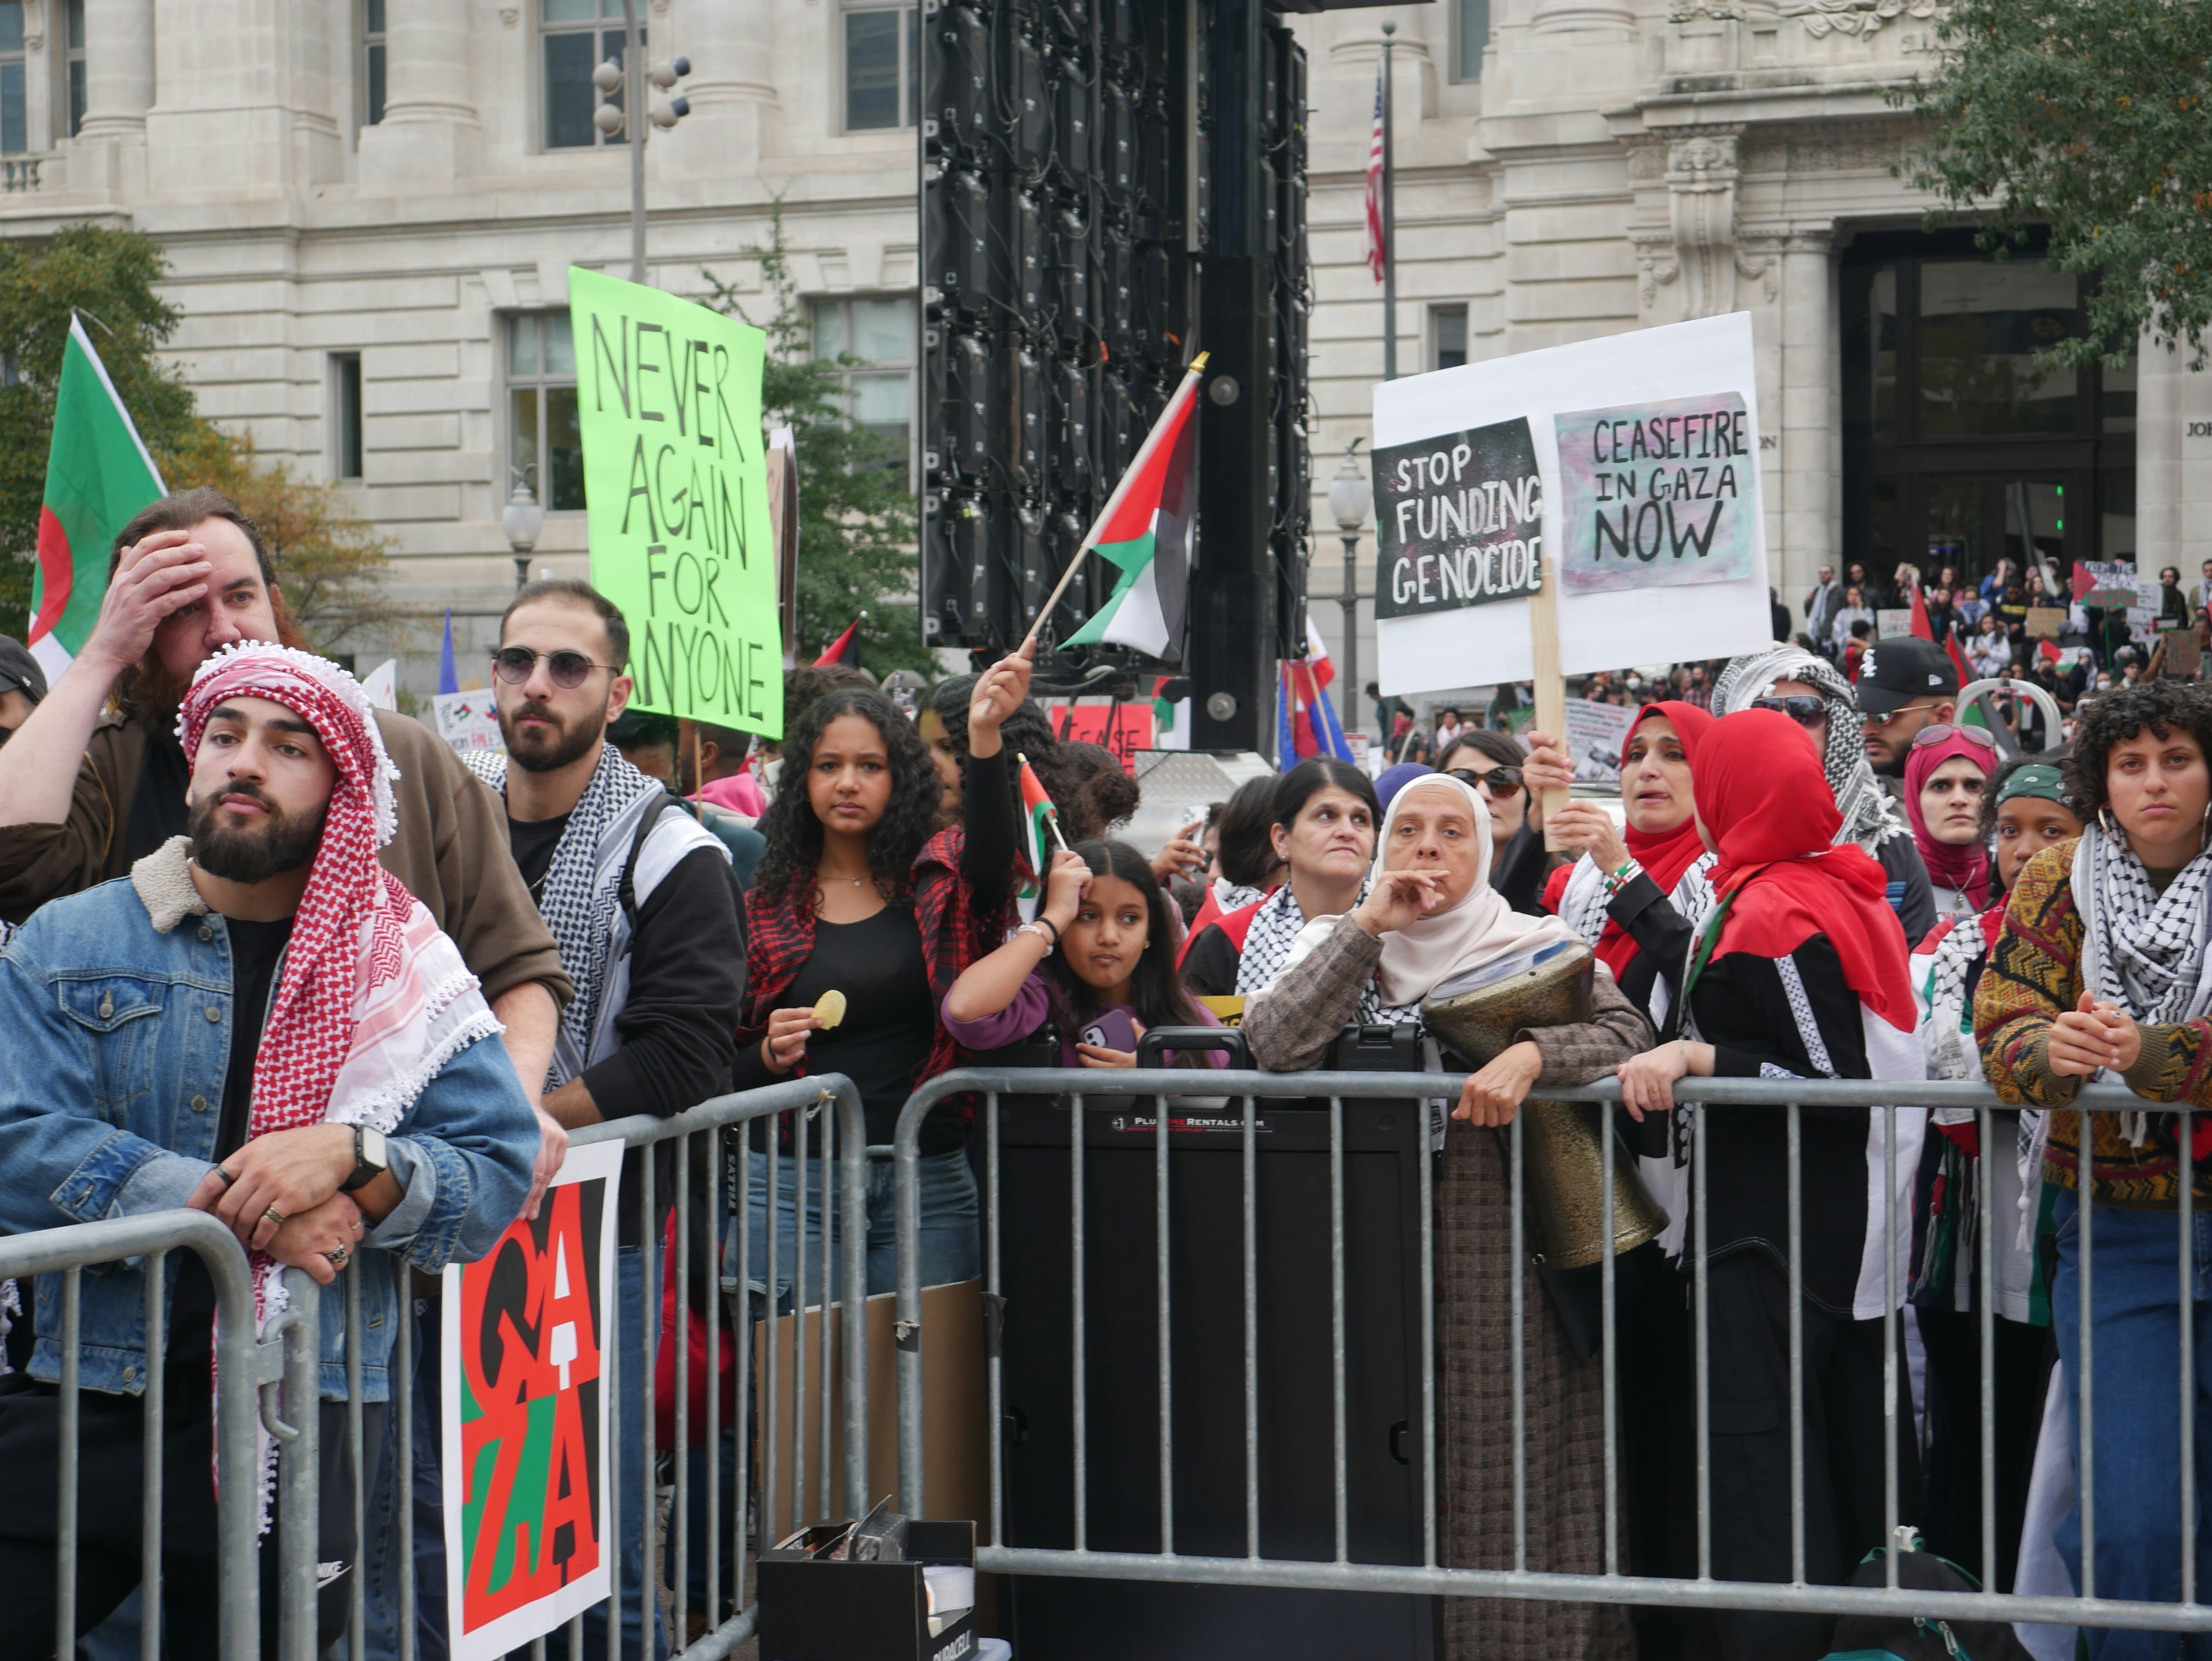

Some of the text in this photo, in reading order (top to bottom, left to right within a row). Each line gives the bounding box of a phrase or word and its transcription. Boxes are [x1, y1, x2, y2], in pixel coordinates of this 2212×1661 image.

[591, 312, 745, 462] NEVER
[1396, 444, 1472, 493] STOP
[1593, 409, 1748, 464] CEASEFIRE
[620, 433, 747, 570] AGAIN
[1396, 475, 1542, 544] FUNDING
[1596, 464, 1738, 502] IN GAZA
[1594, 500, 1724, 562] NOW
[647, 544, 730, 629] FOR
[1392, 536, 1542, 605] GENOCIDE
[727, 1153, 737, 1209] TILLYS
